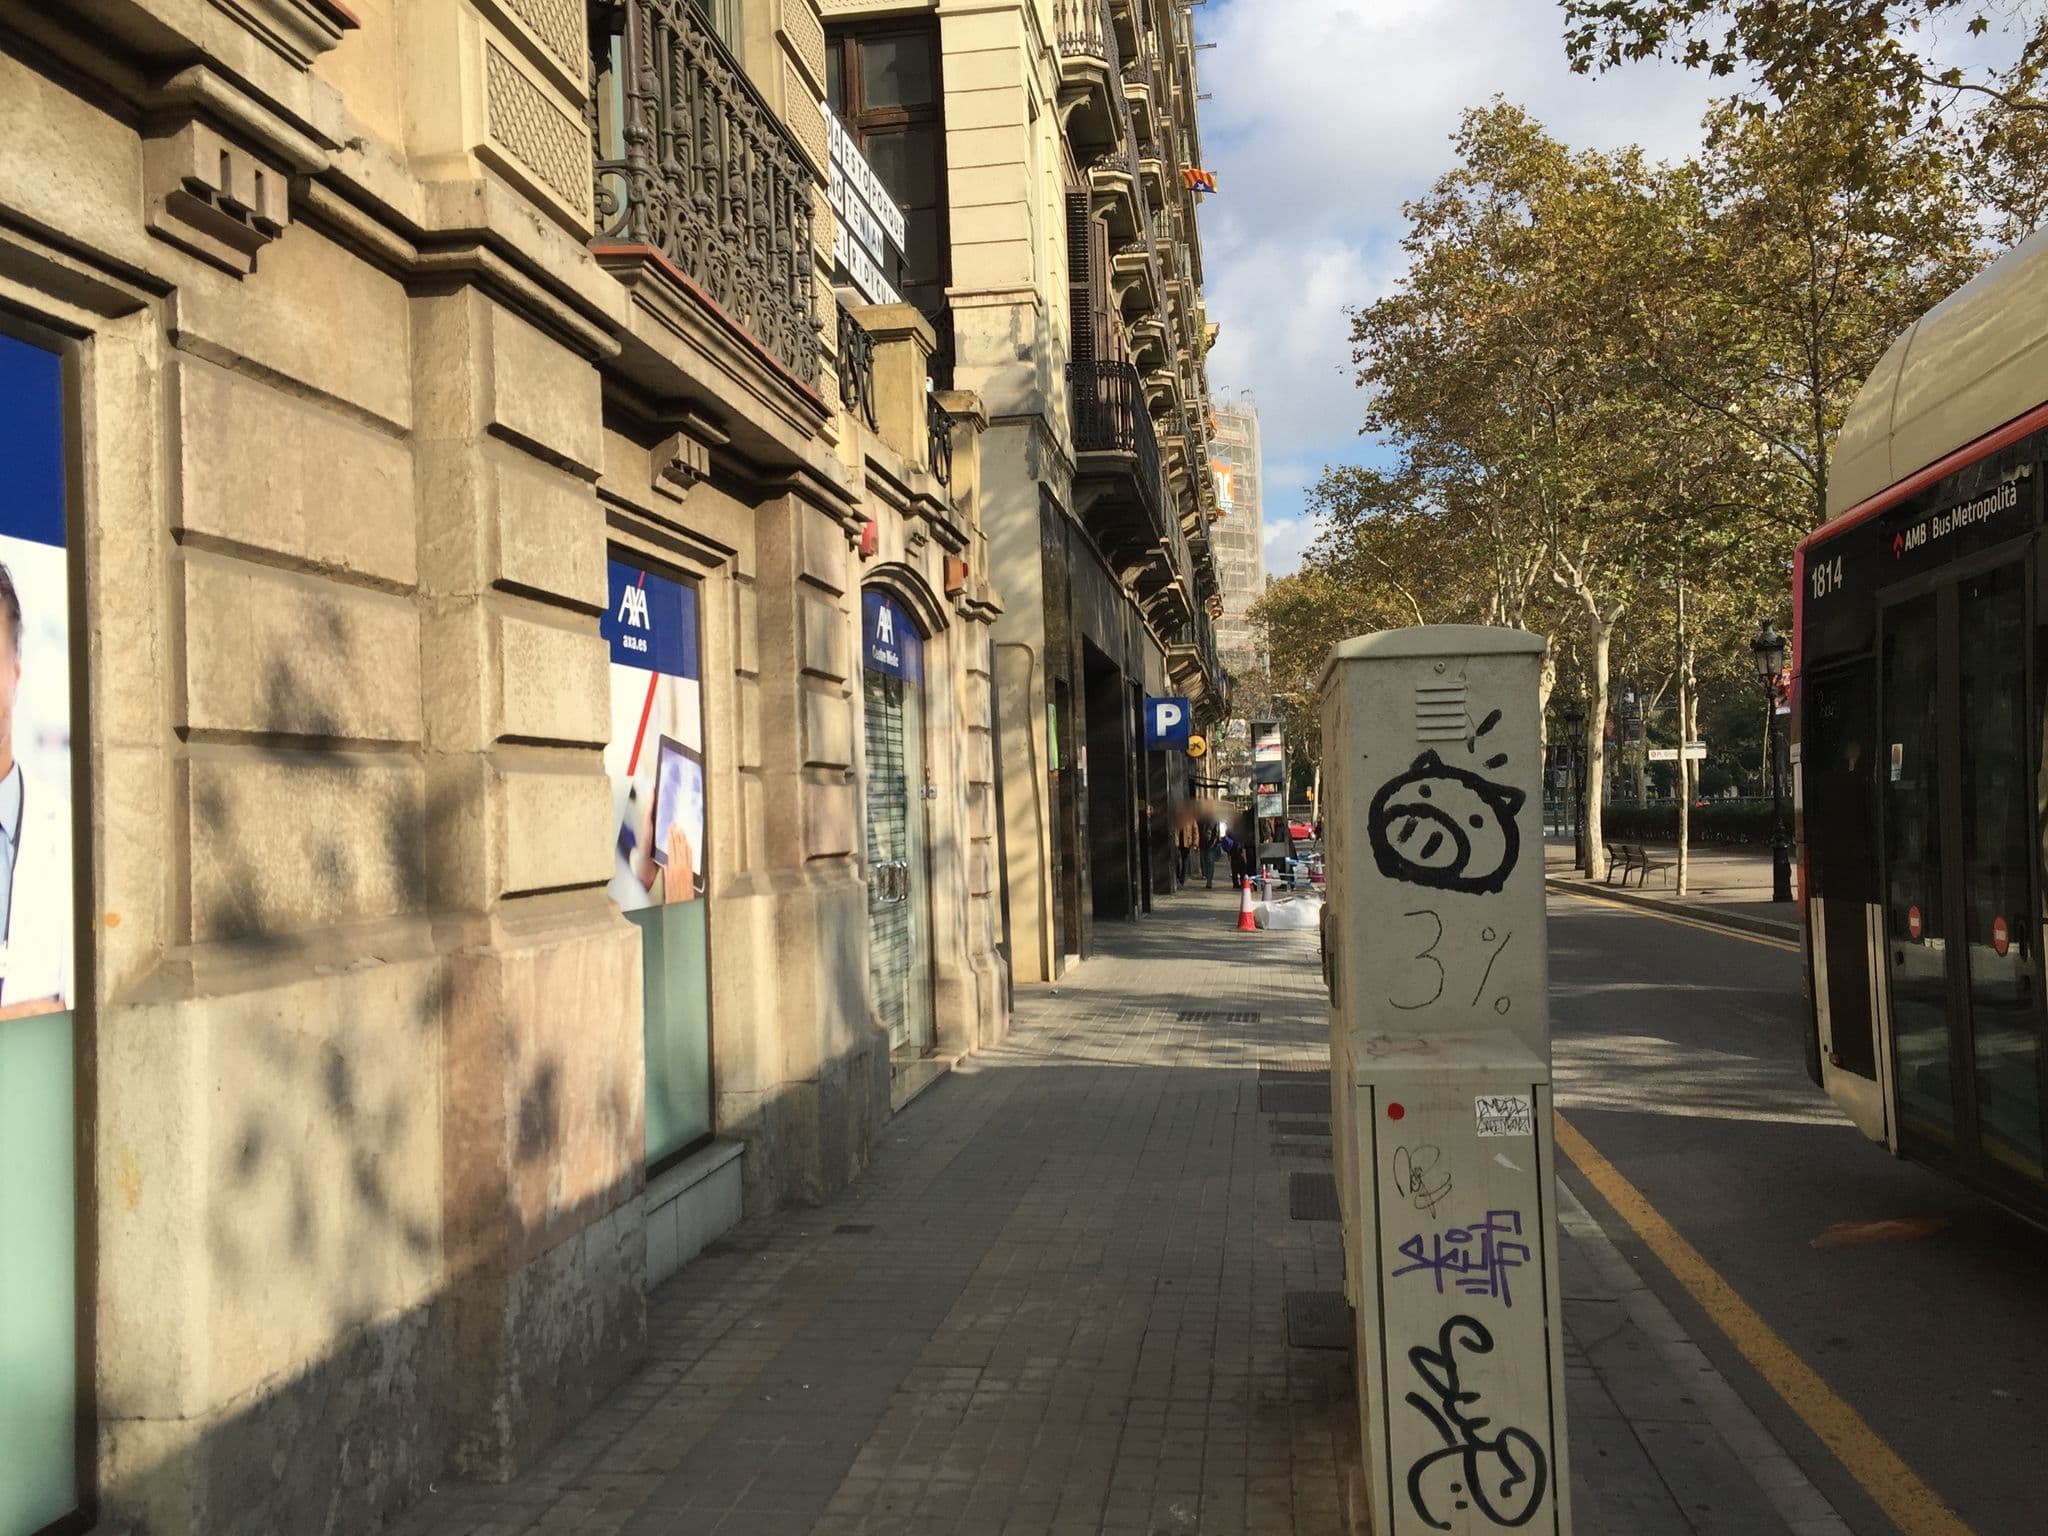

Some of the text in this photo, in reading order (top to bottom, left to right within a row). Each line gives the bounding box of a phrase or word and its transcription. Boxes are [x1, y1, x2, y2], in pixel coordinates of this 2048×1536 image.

[844, 141, 869, 192] ESTO
[871, 183, 904, 244] PORQUE
[1905, 480, 2018, 551] AMB Bus Metropolità
[1812, 555, 1843, 600] 1814
[617, 584, 651, 631] AXA
[622, 634, 648, 653] axa.es
[1156, 703, 1182, 737] P
